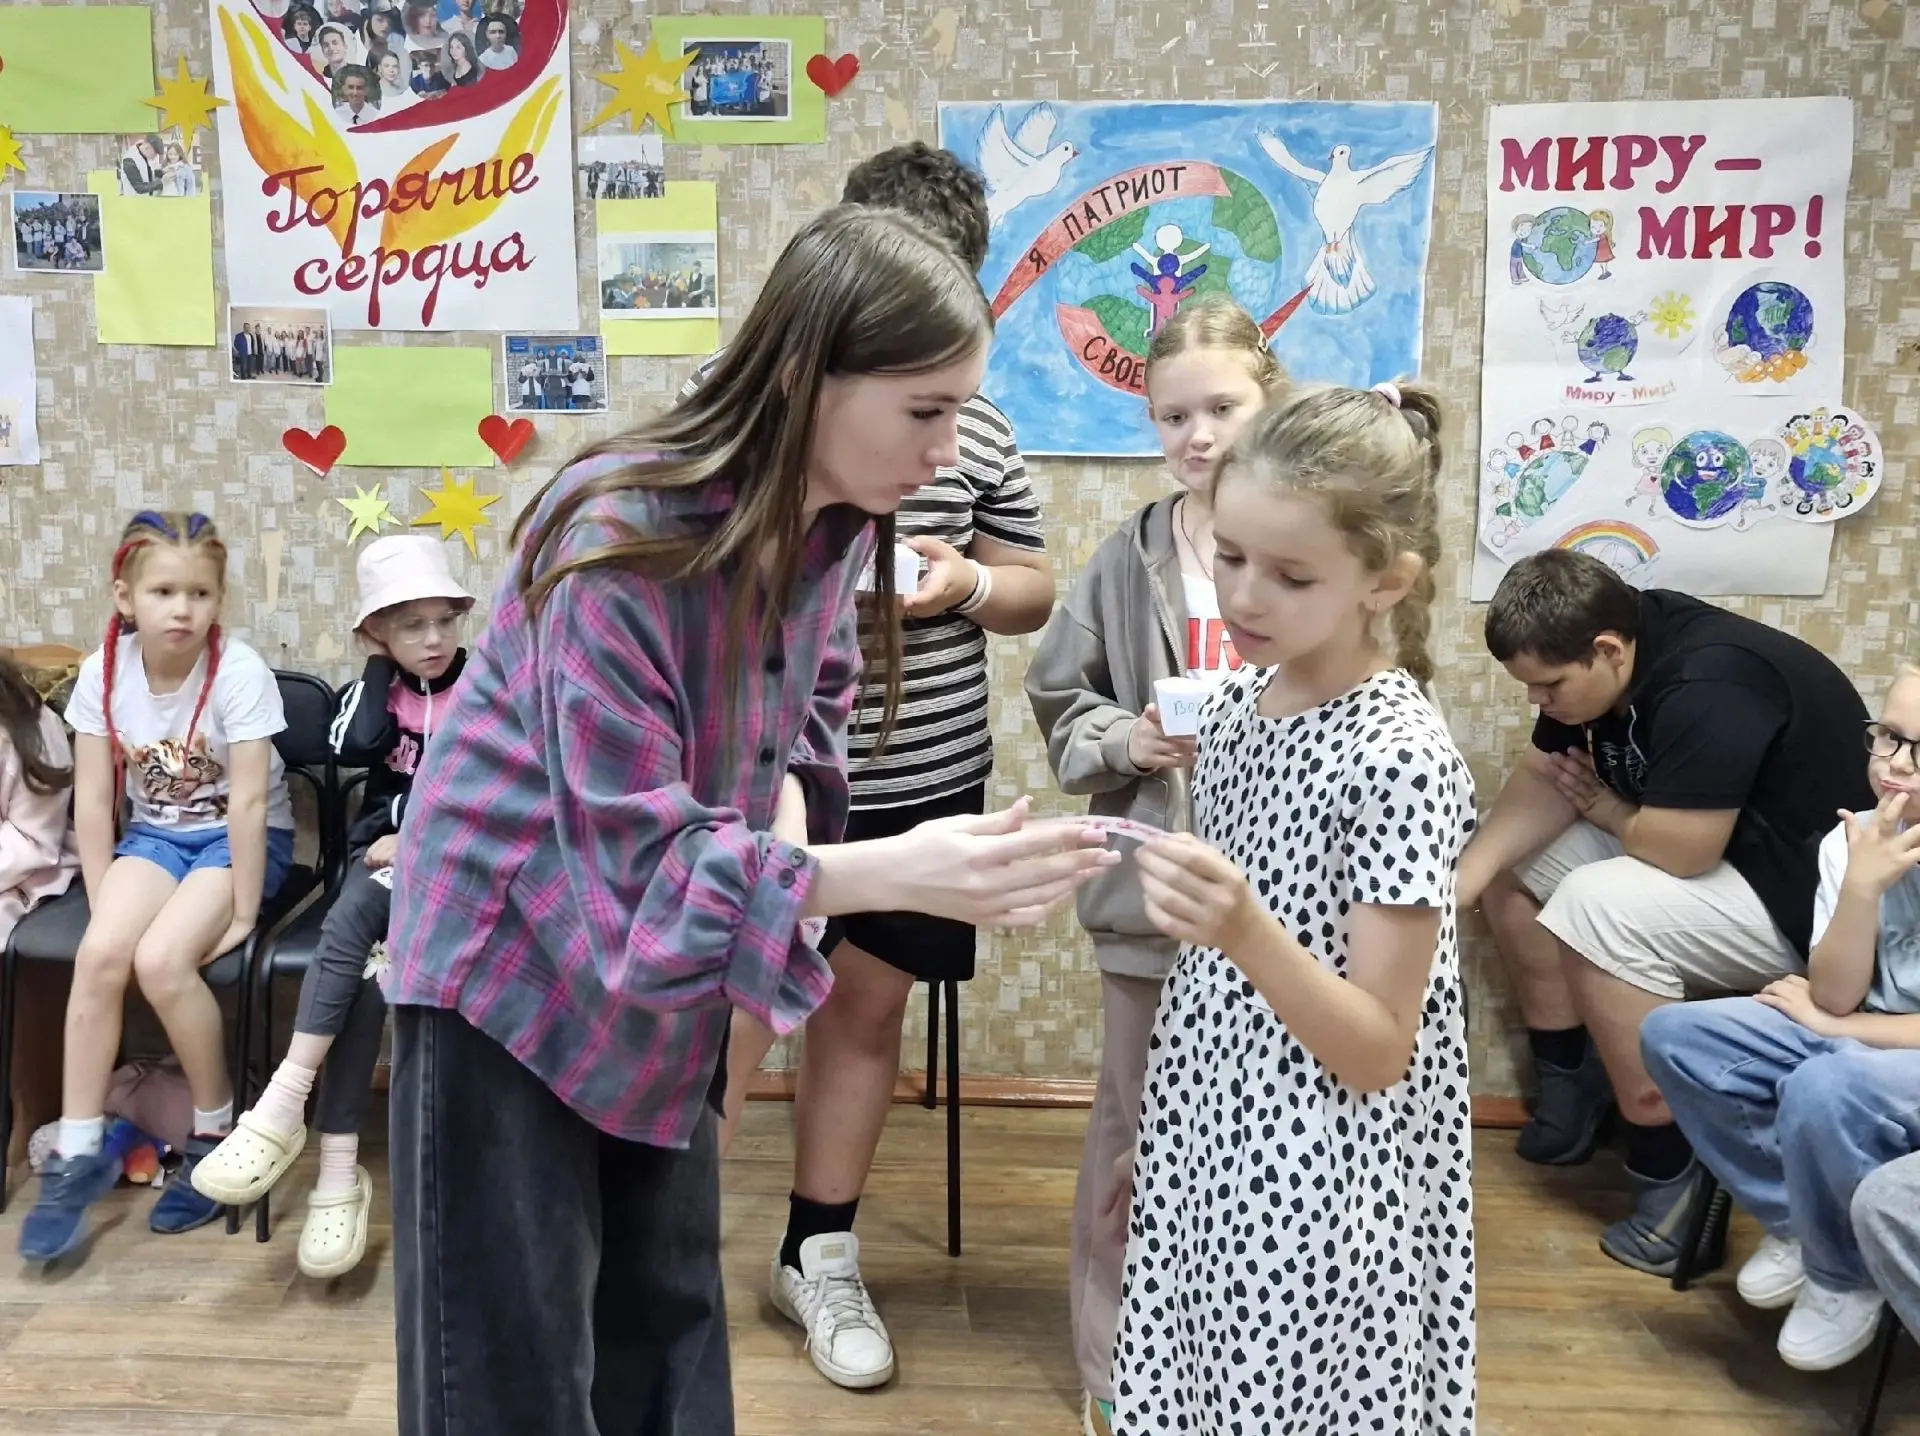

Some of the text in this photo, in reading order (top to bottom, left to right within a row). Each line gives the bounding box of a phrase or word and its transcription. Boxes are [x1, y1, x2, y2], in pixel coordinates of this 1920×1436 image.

[1499, 134, 1707, 194] МИРУ
[261, 152, 540, 260] Горячие
[1028, 166, 1187, 273] Я ПАТРИОТ
[1637, 194, 1825, 260] МИР!
[293, 231, 537, 328] сердца
[1083, 335, 1146, 389] СВОЕ
[1565, 385, 1616, 405] Миру
[1173, 699, 1201, 716] Во
